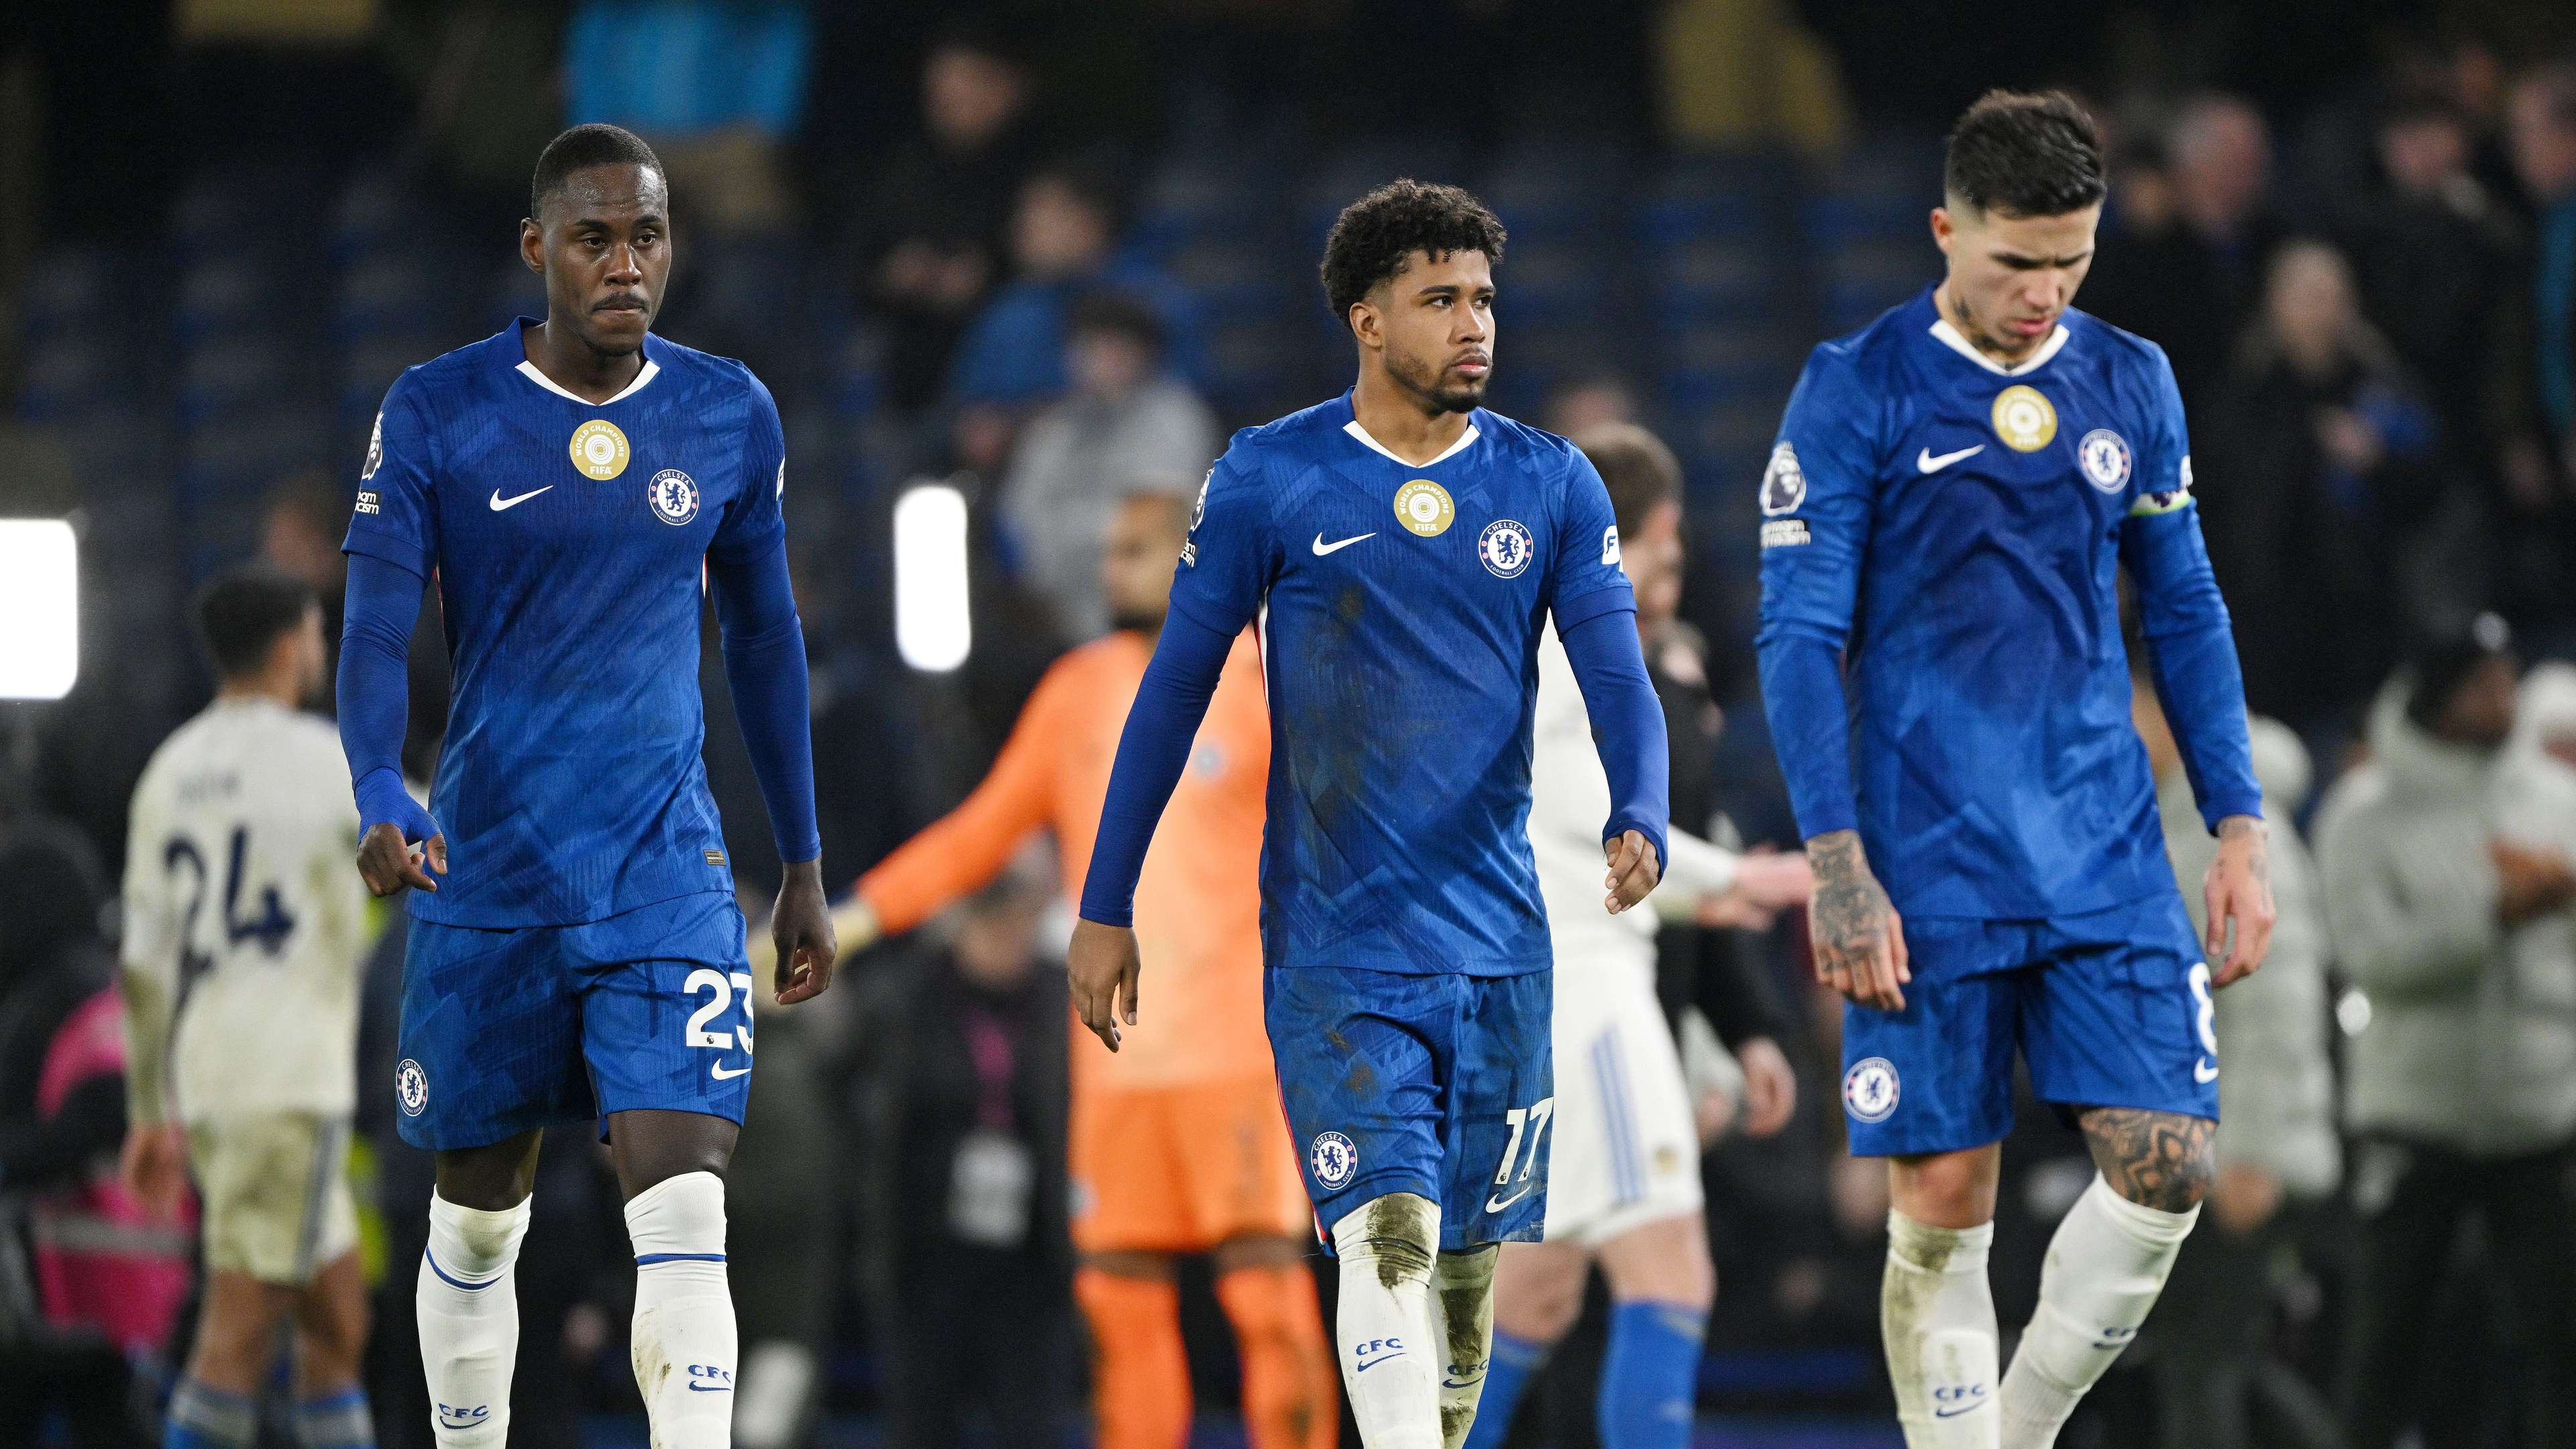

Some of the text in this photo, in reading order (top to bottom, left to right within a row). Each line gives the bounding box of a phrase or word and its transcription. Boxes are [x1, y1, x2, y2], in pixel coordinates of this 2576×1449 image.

[576, 425, 625, 457] WORLD CHAMPIONS
[590, 466, 612, 474] FIFA
[657, 471, 690, 485] CHELSEA
[1399, 484, 1449, 515] WORLD CHAMPIONS
[658, 509, 691, 522] FOOTBALL CLUB
[1414, 523, 1438, 532] FIFA
[1487, 522, 1523, 535] CHELSEA
[1490, 564, 1524, 575] FOOTBALL CLUB
[162, 825, 297, 971] 24
[683, 968, 754, 1055] 23
[401, 1061, 422, 1077] CHELSEA
[1314, 1133, 1342, 1151] CHELSEA
[1494, 1096, 1554, 1185] 17
[1356, 1338, 1403, 1356] CFC
[688, 1364, 731, 1384] CFC
[1447, 1358, 1489, 1376] CFC
[1935, 1382, 1986, 1402] CFC
[438, 1403, 489, 1419] CFC
